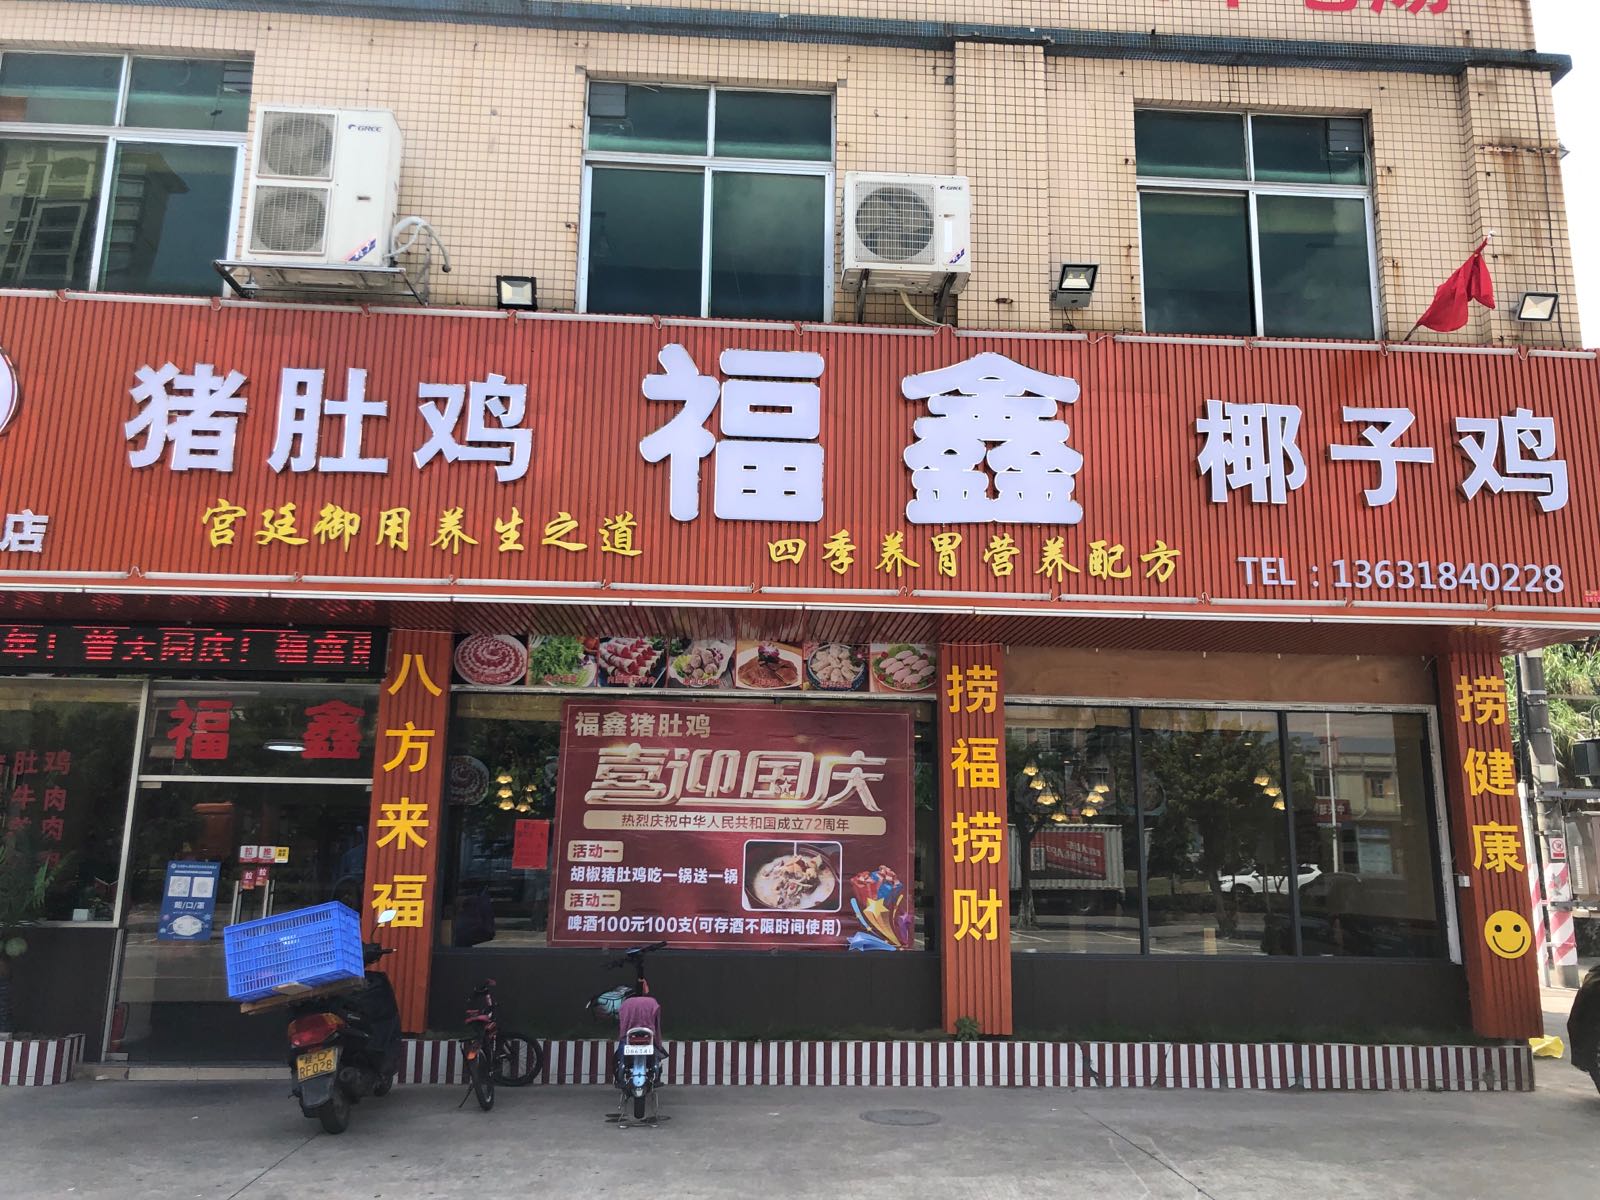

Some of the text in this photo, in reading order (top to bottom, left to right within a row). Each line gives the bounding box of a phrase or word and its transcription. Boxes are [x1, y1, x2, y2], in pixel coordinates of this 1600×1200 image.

[124, 361, 534, 483] 猪肚鸡
[640, 342, 1084, 525] 福鑫
[1196, 398, 1569, 513] 椰子鸡
[201, 498, 643, 557] 宫廷御用养生之道
[767, 530, 1182, 584] 四季养胃营养配方
[167, 699, 366, 760] 福鑫
[574, 711, 711, 738] 福鑫猪肚鸡
[0, 750, 72, 775] 肚鸡
[370, 653, 443, 929] 八方来福
[584, 742, 888, 812] 喜迎国庆
[1455, 674, 1525, 874] 捞健康
[620, 813, 850, 832] 热烈庆祝中华人民共和国成立72周年
[945, 664, 1004, 942] 捞福捞财
[570, 866, 738, 885] 胡椒猪肚鸡吃一锅送一锅
[572, 844, 619, 859] 活动一
[567, 915, 842, 937] 啤酒100元100支(可存酒不限时间使用)
[569, 892, 616, 908] 活动二
